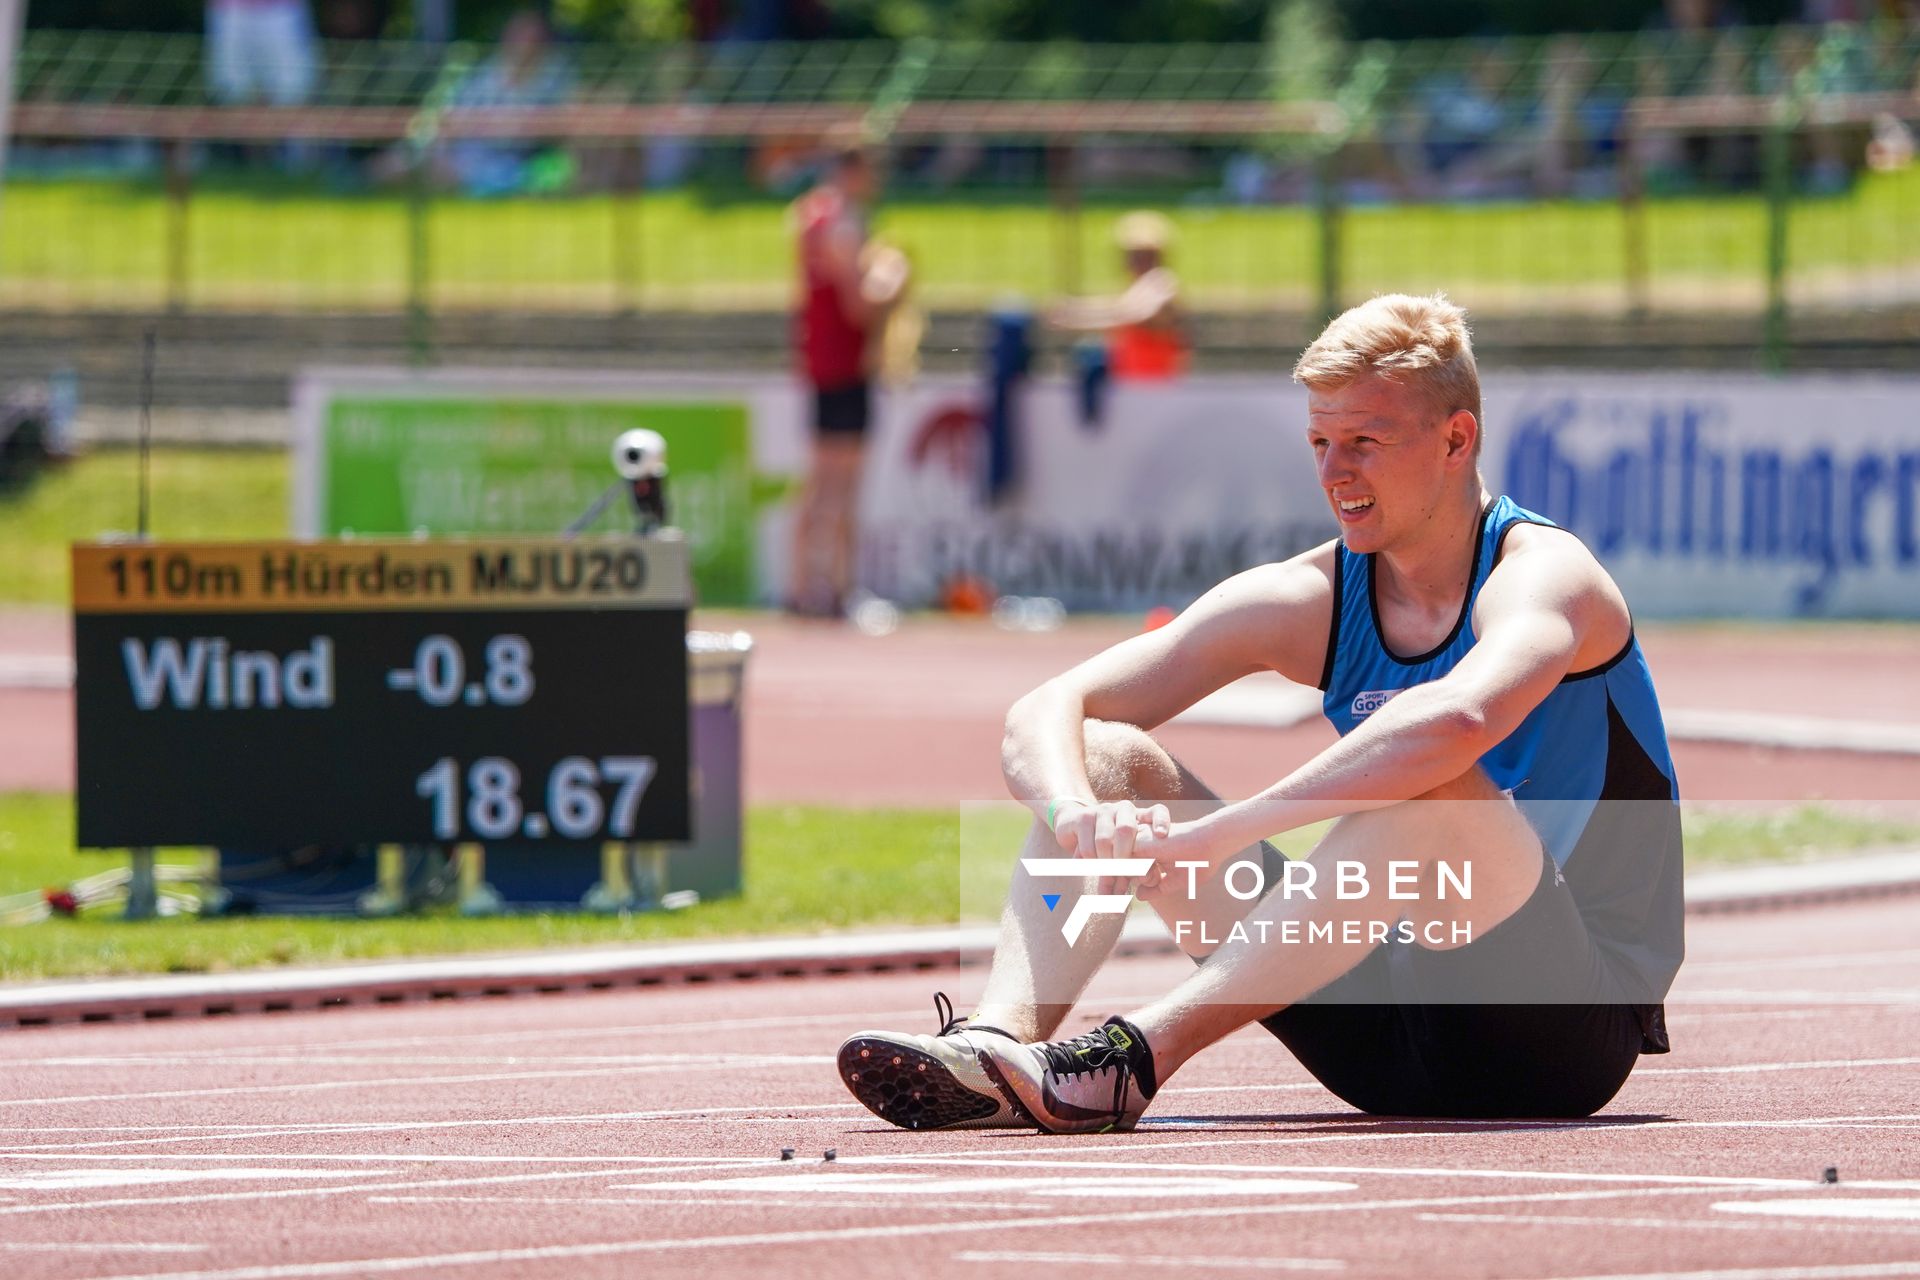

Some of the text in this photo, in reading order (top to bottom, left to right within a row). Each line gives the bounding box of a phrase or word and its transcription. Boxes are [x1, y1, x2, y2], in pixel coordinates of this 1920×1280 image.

[108, 550, 648, 596] 110m Hürden MJU20
[122, 633, 536, 710] Wind -0.8
[415, 755, 658, 840] 18.67
[1110, 1030, 1129, 1046] NIKE
